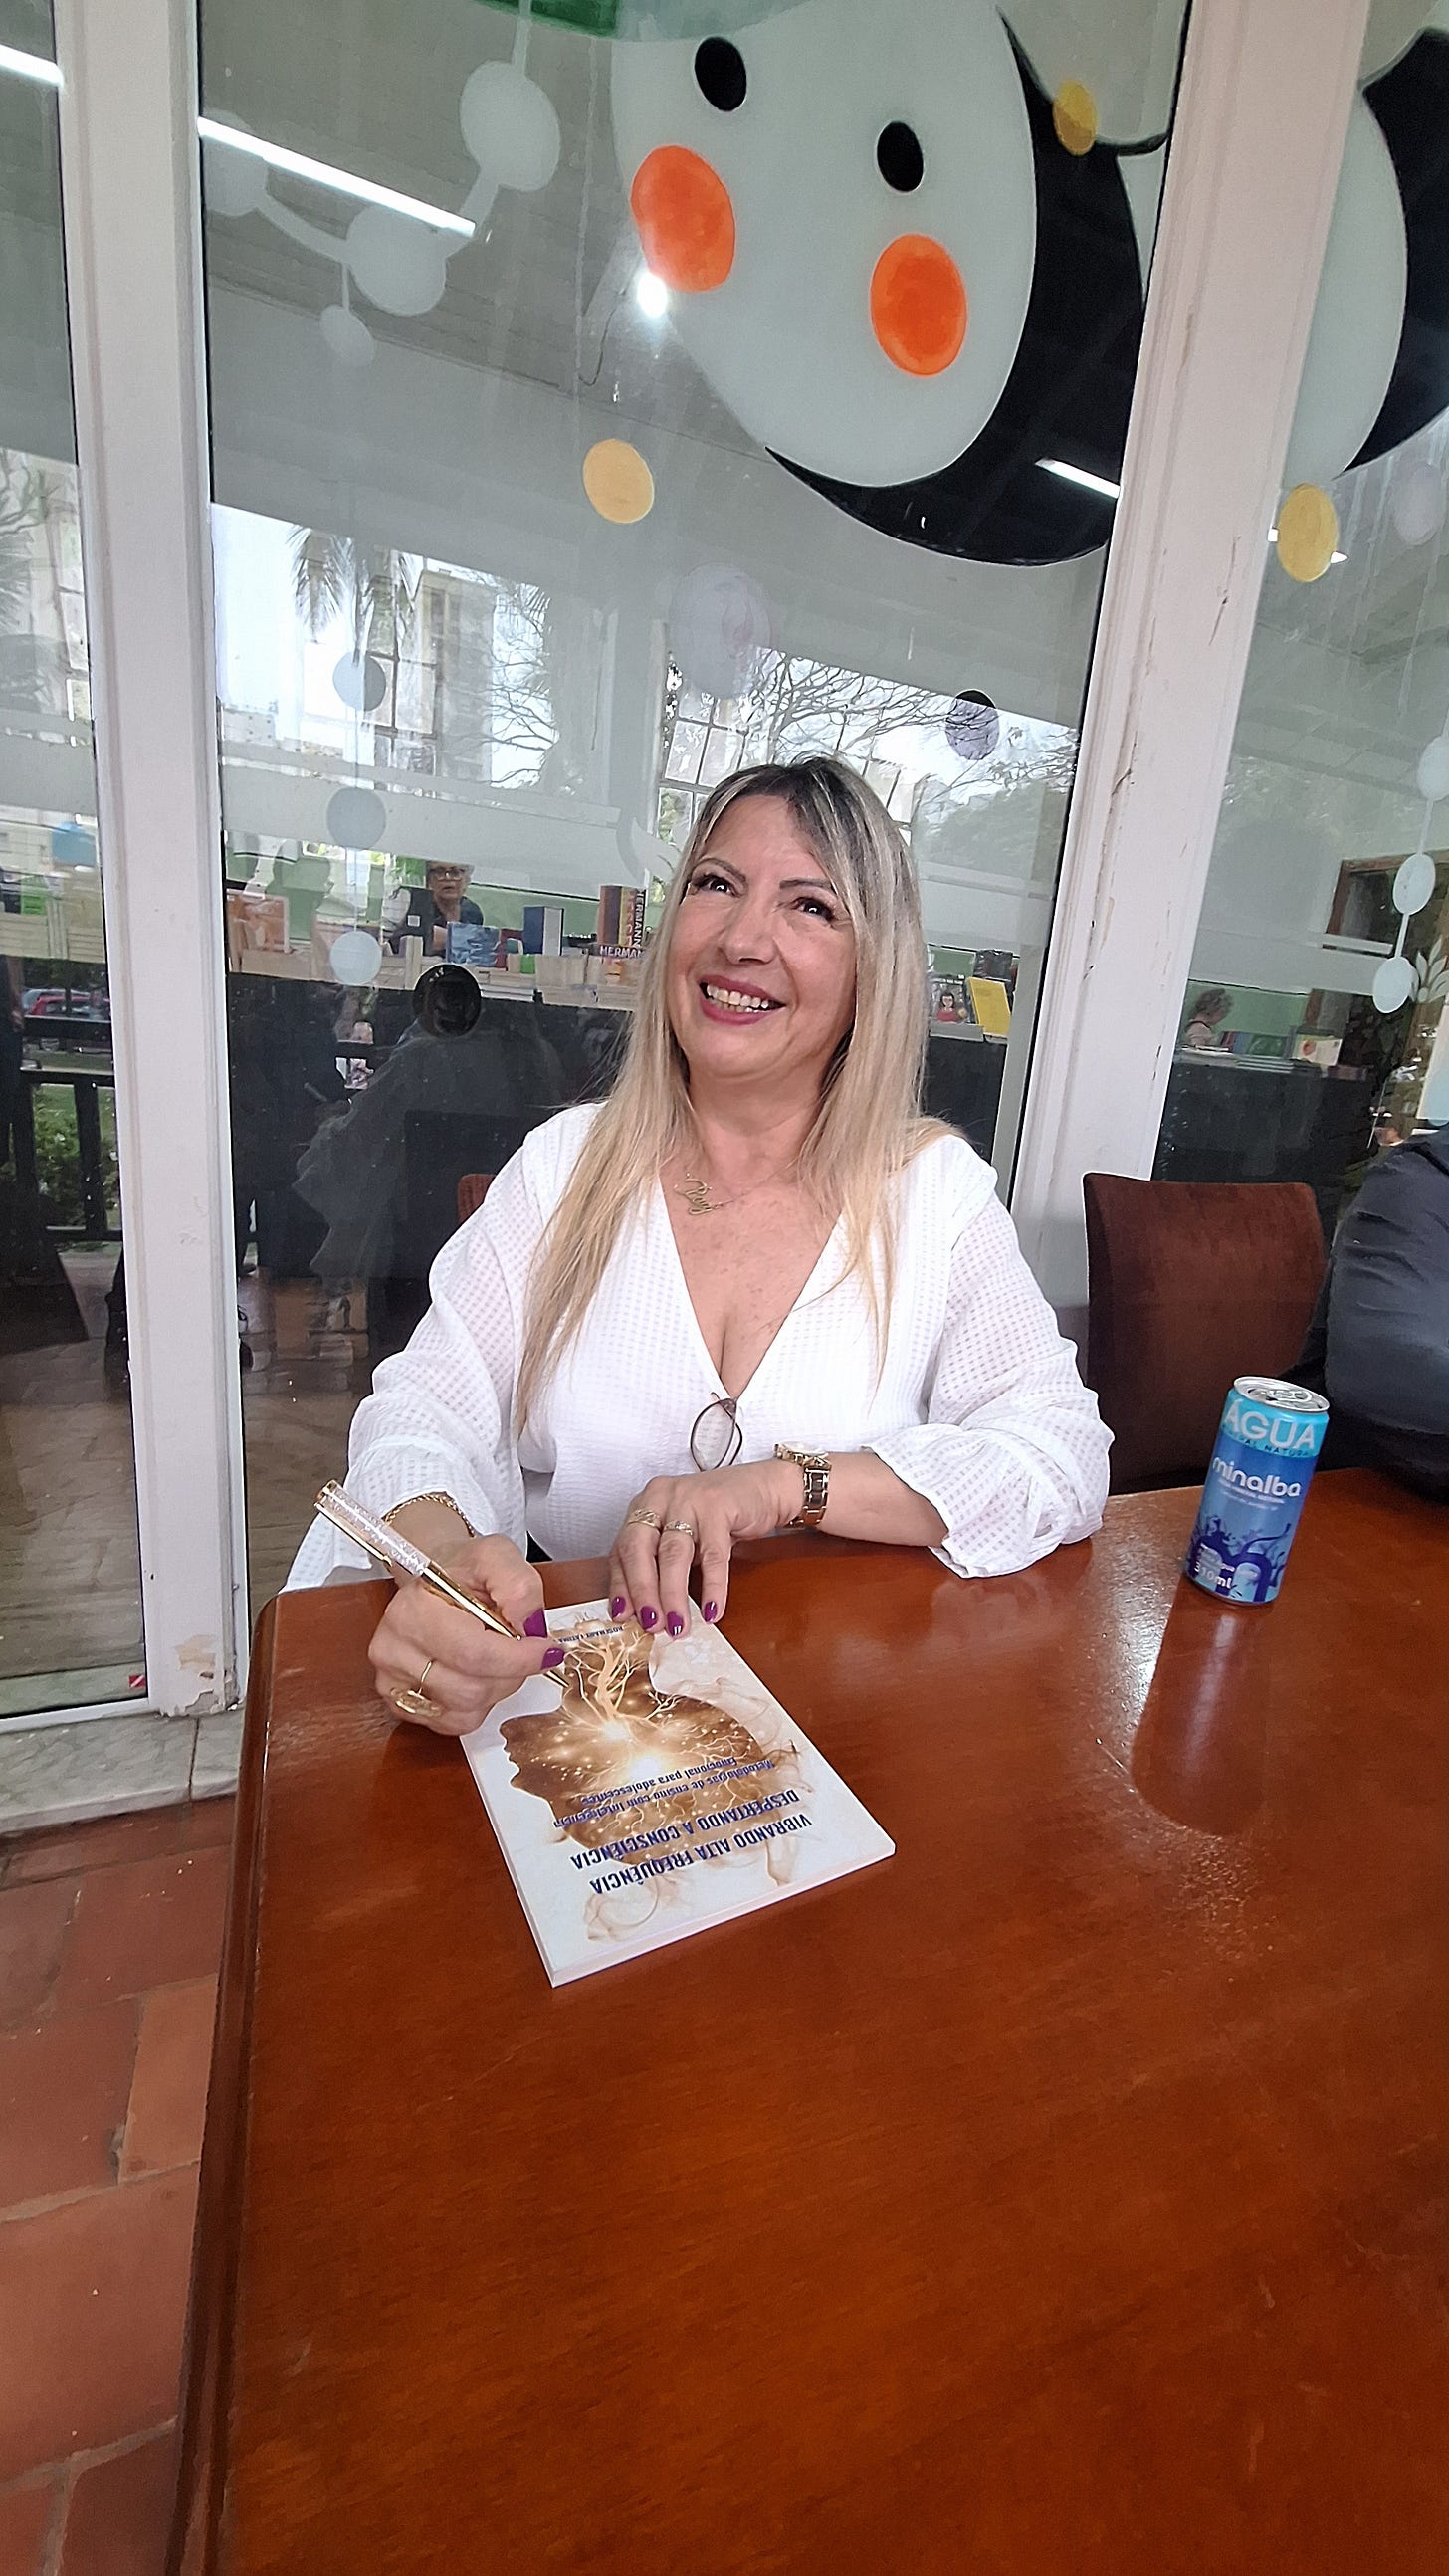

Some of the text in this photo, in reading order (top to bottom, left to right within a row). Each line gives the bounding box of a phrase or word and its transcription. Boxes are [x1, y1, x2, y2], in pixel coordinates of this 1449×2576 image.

[1213, 1457, 1301, 1497] minalba
[581, 1757, 737, 1805] Emocional para adolescentes
[691, 1780, 705, 1790] de
[707, 1759, 775, 1785] Metodologias
[627, 1795, 650, 1807] com
[654, 1785, 689, 1800] ensino
[570, 1790, 800, 1869] DESPERTANDO A CONSCIÊNCIA
[589, 1814, 812, 1894] VIBRANDO ALTA FREQUÊNCIA
